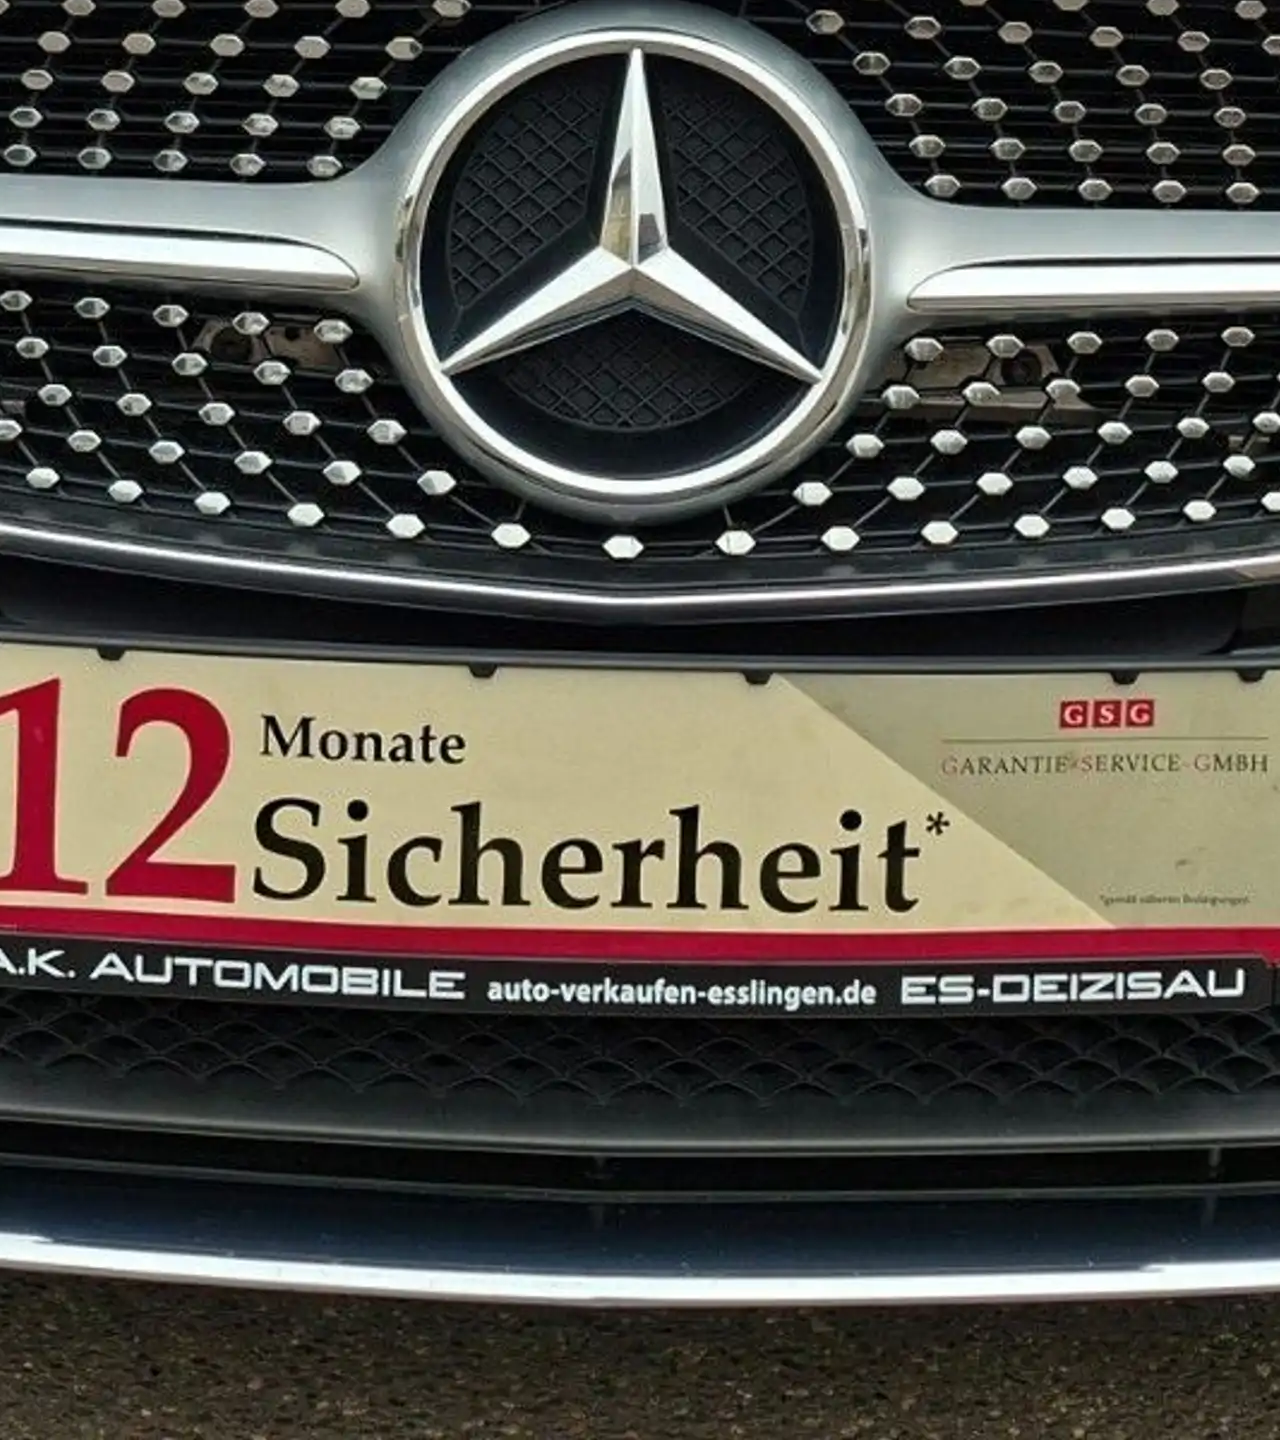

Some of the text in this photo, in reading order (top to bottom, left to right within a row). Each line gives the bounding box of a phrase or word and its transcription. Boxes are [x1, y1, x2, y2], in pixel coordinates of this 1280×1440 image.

[261, 715, 466, 764] Monate
[1062, 702, 1154, 728] GSG
[89, 952, 467, 1000] AUTOMOBILE
[487, 976, 877, 1012] auto-verkaufen-esslingen.de
[900, 968, 1245, 1005] ES-DEIZISAU
